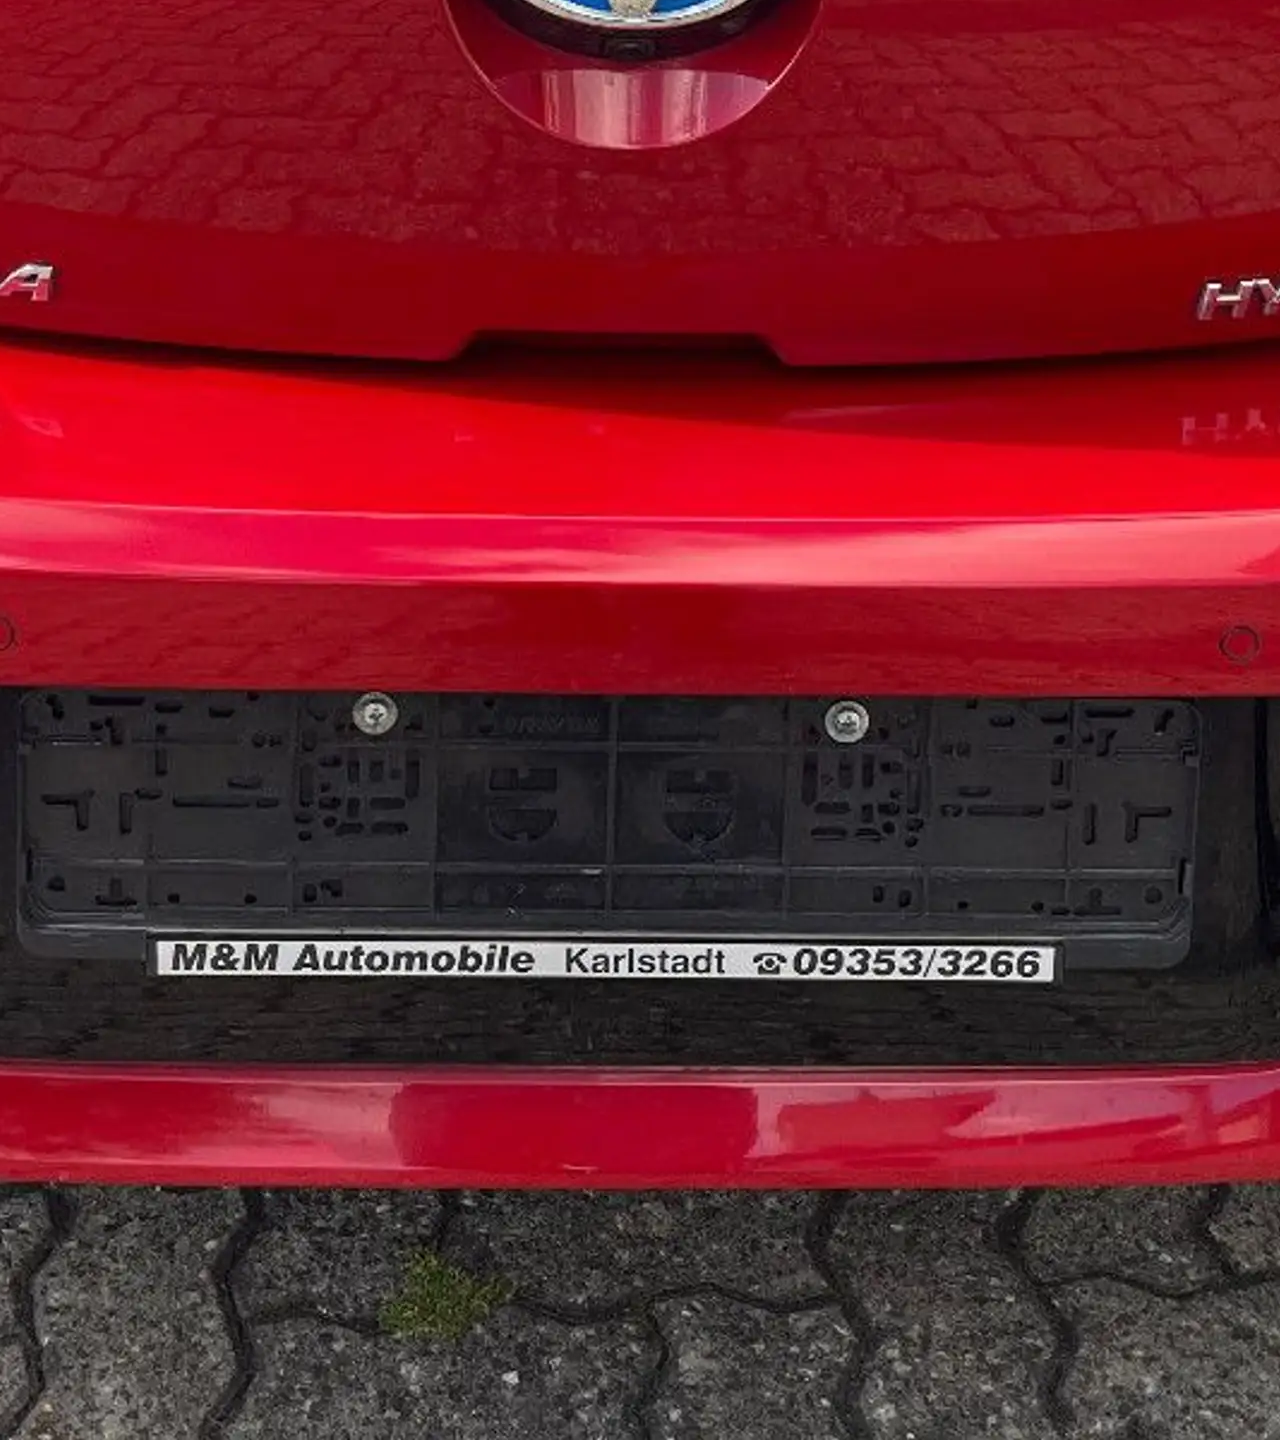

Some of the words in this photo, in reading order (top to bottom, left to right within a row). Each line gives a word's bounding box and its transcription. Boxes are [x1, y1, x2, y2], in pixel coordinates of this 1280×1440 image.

[171, 943, 279, 971] M&M
[292, 944, 535, 973] Automobile
[565, 947, 726, 974] Karlstadt
[793, 946, 1041, 978] 09353/3266
